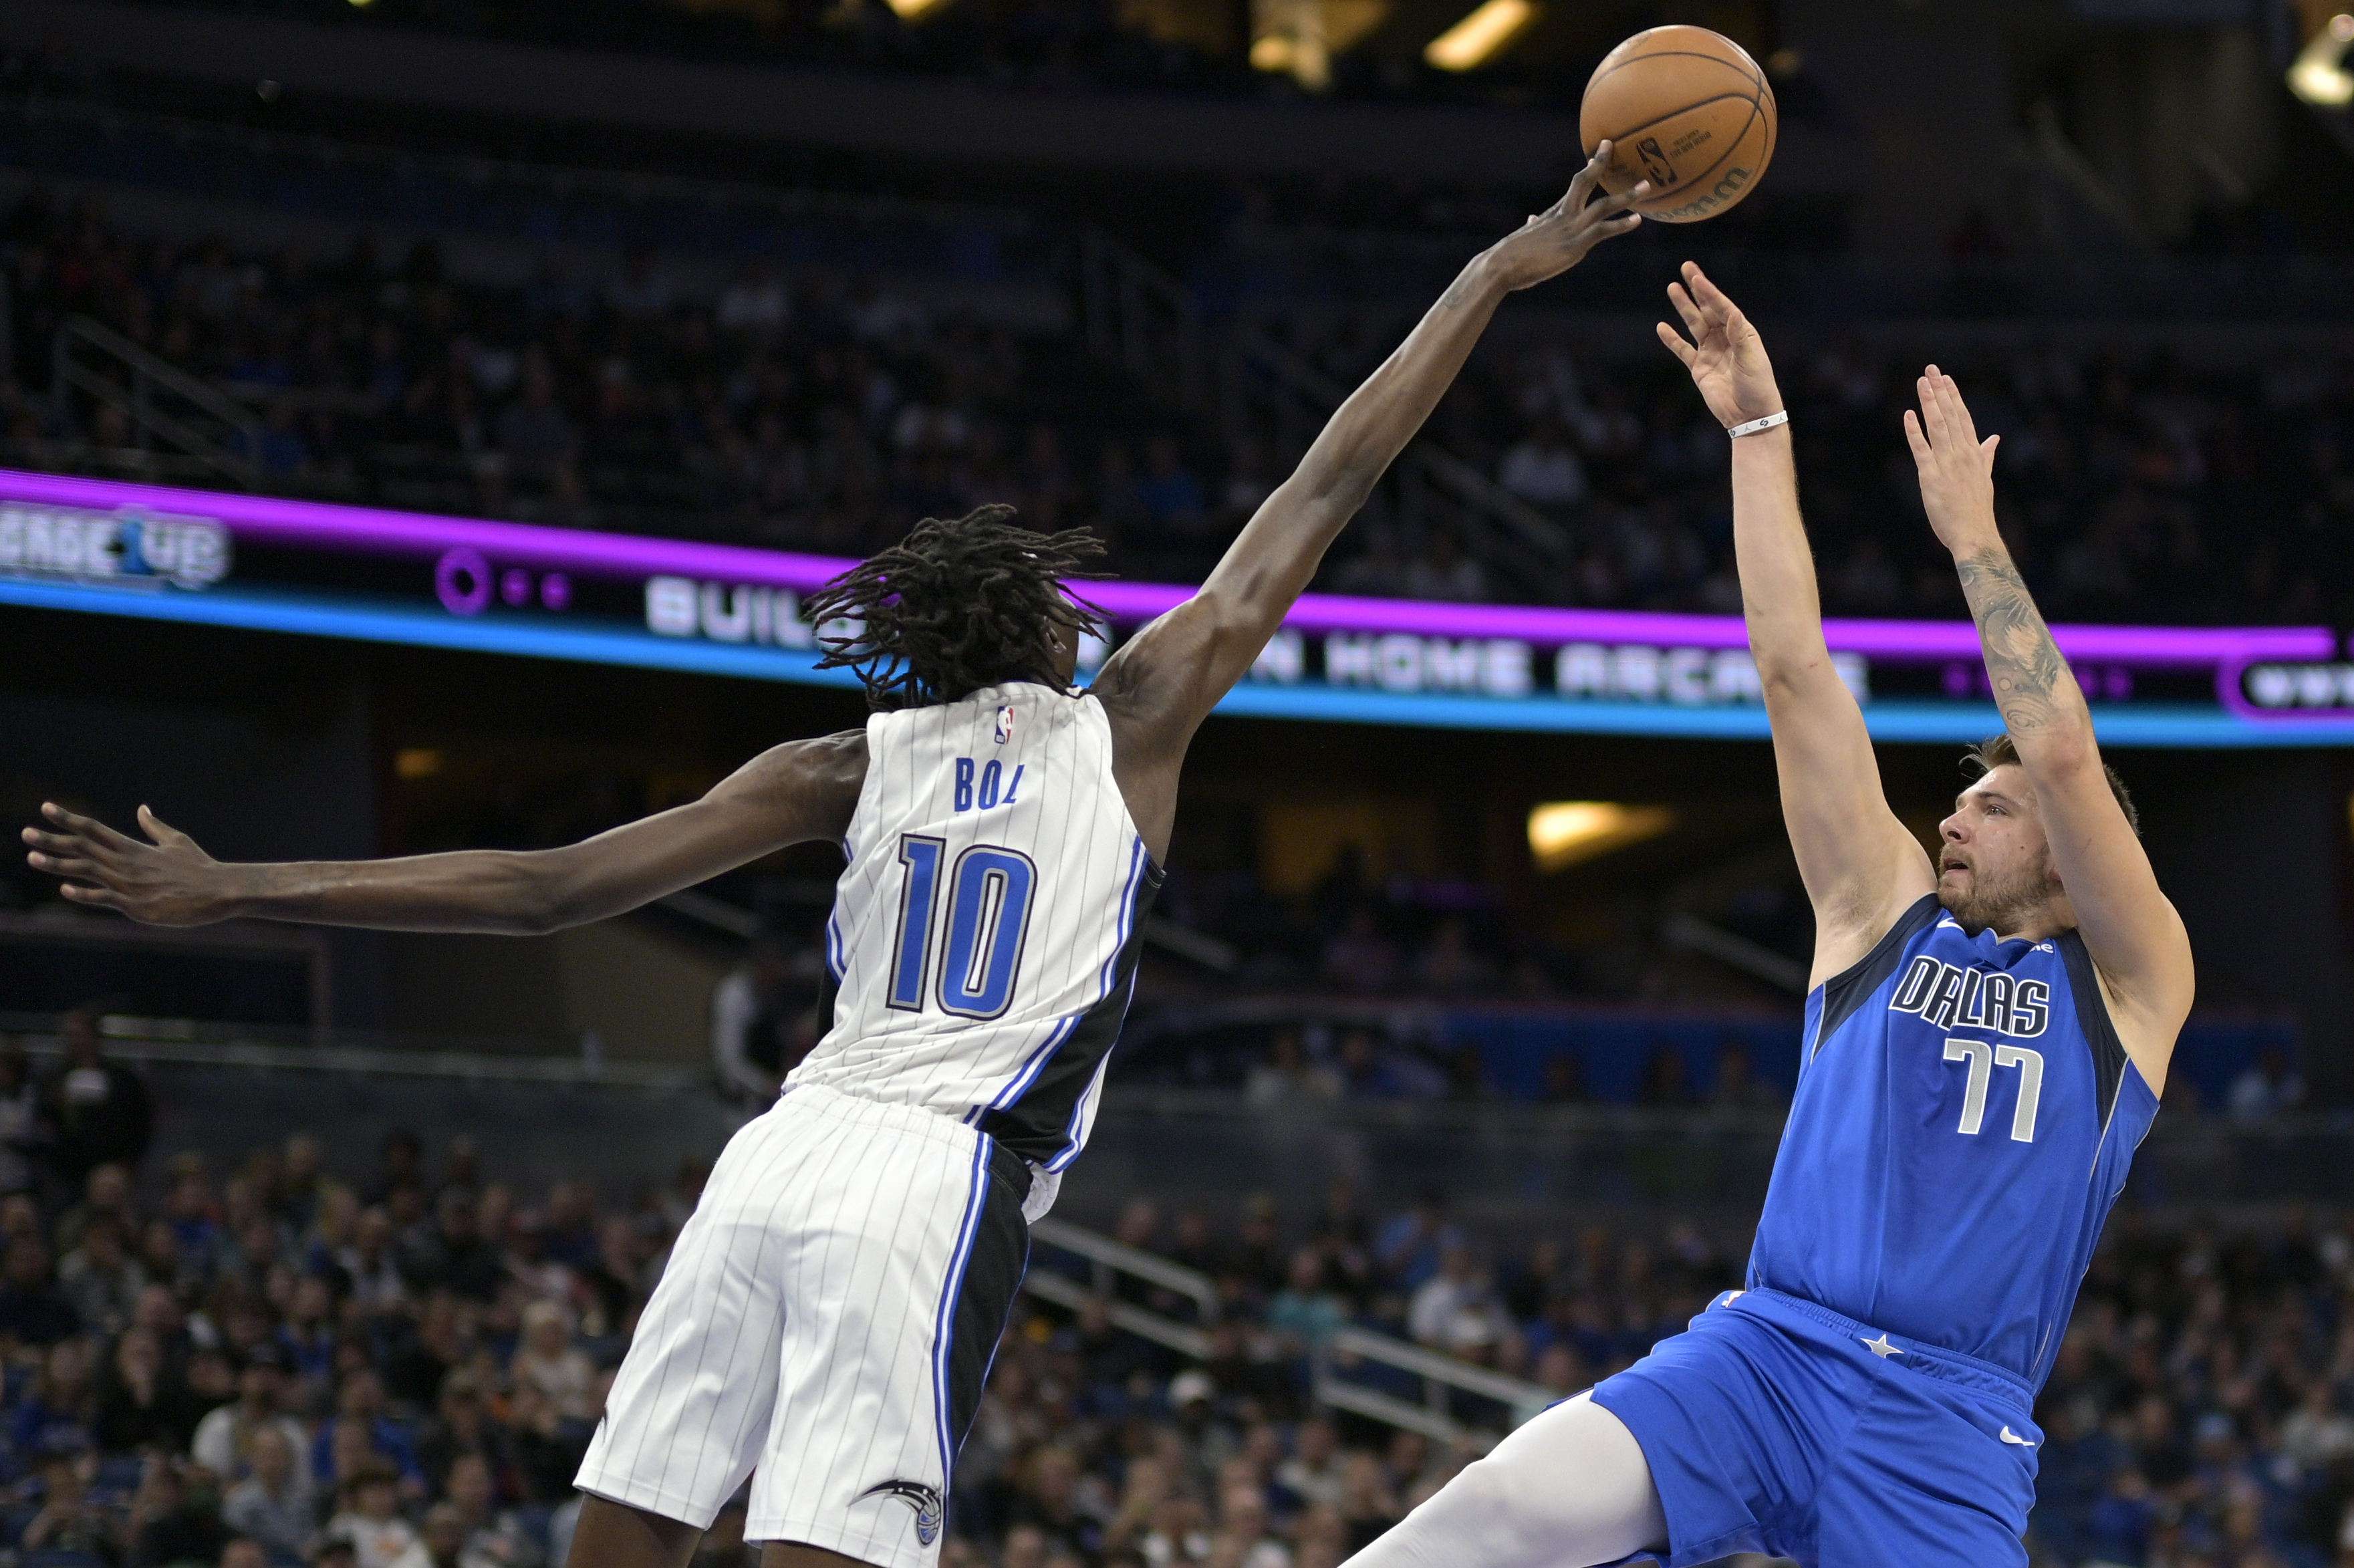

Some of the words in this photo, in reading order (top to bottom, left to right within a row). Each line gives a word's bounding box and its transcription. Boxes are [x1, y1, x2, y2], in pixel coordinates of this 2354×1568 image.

[1323, 629, 1535, 697] HOME
[886, 833, 1038, 1021] 10
[1943, 1038, 2044, 1143] 77
